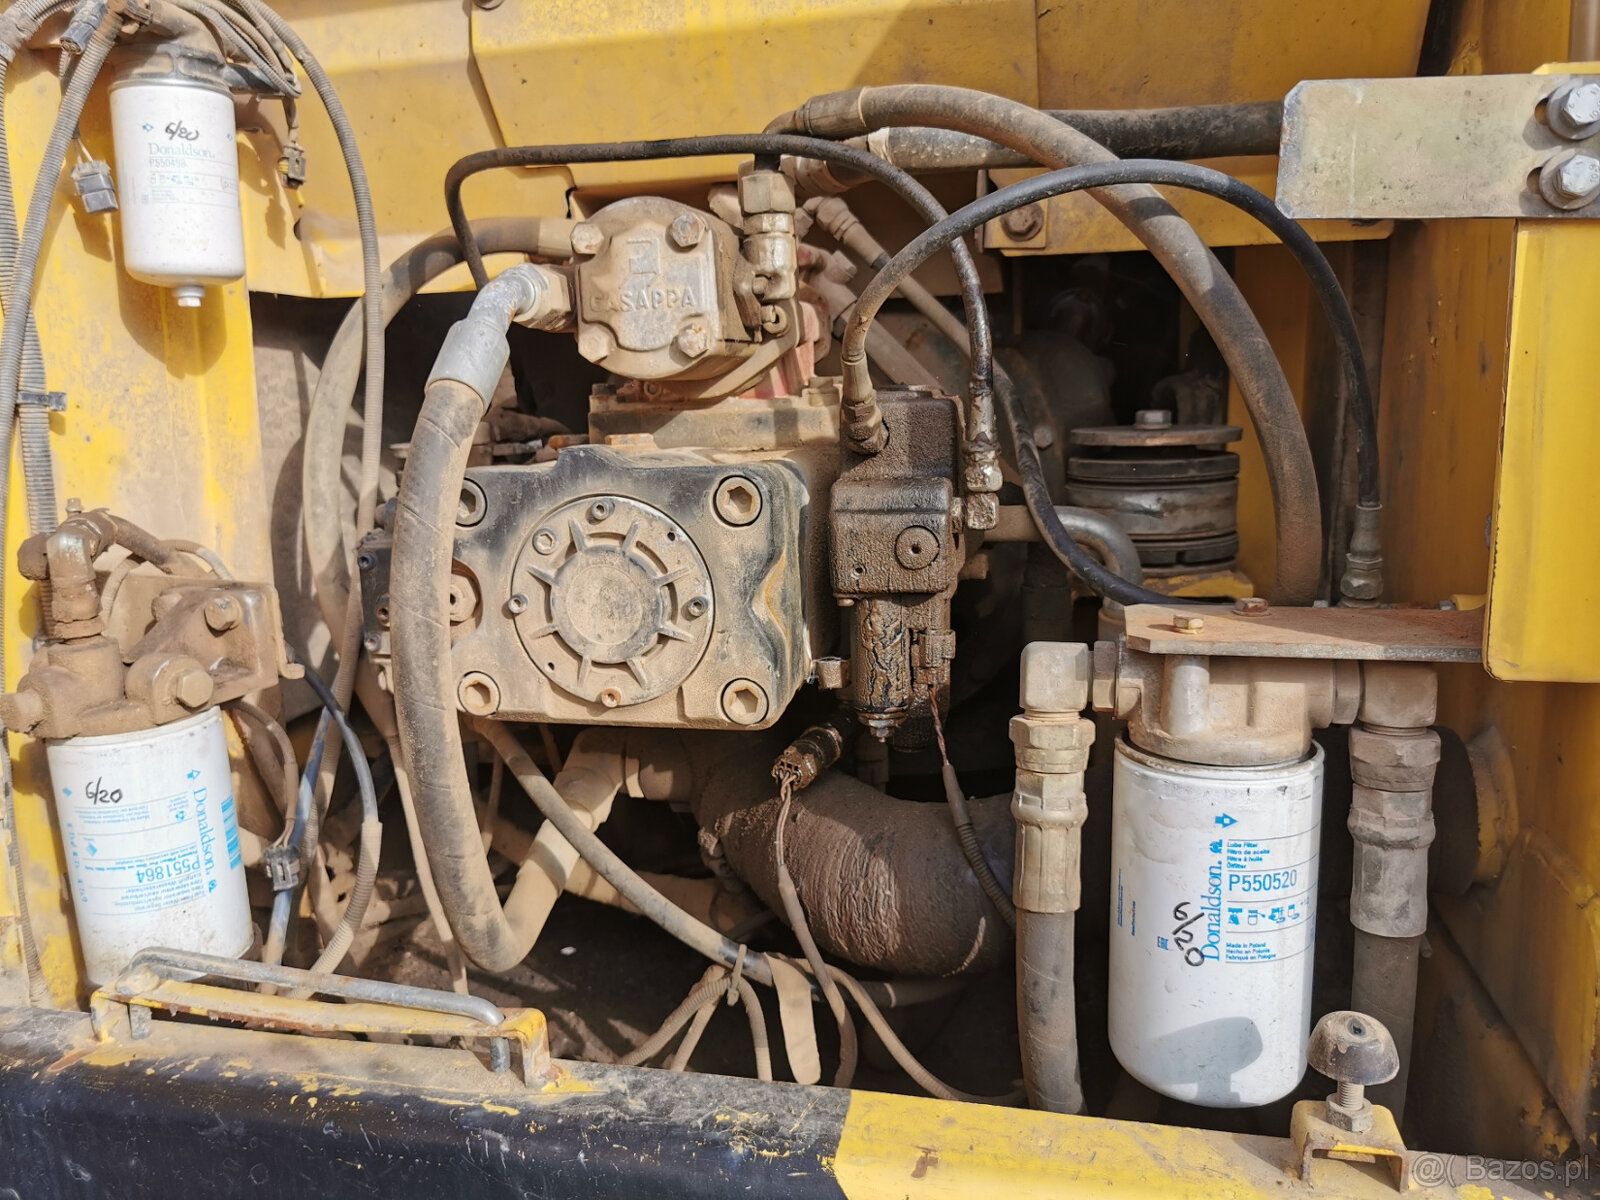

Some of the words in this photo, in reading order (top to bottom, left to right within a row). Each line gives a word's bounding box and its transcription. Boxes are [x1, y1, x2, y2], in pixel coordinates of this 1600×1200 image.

[85, 776, 123, 805] 6/20
[136, 854, 200, 884] P551864
[1228, 869, 1298, 892] P550520
[1172, 901, 1205, 967] 6/20
